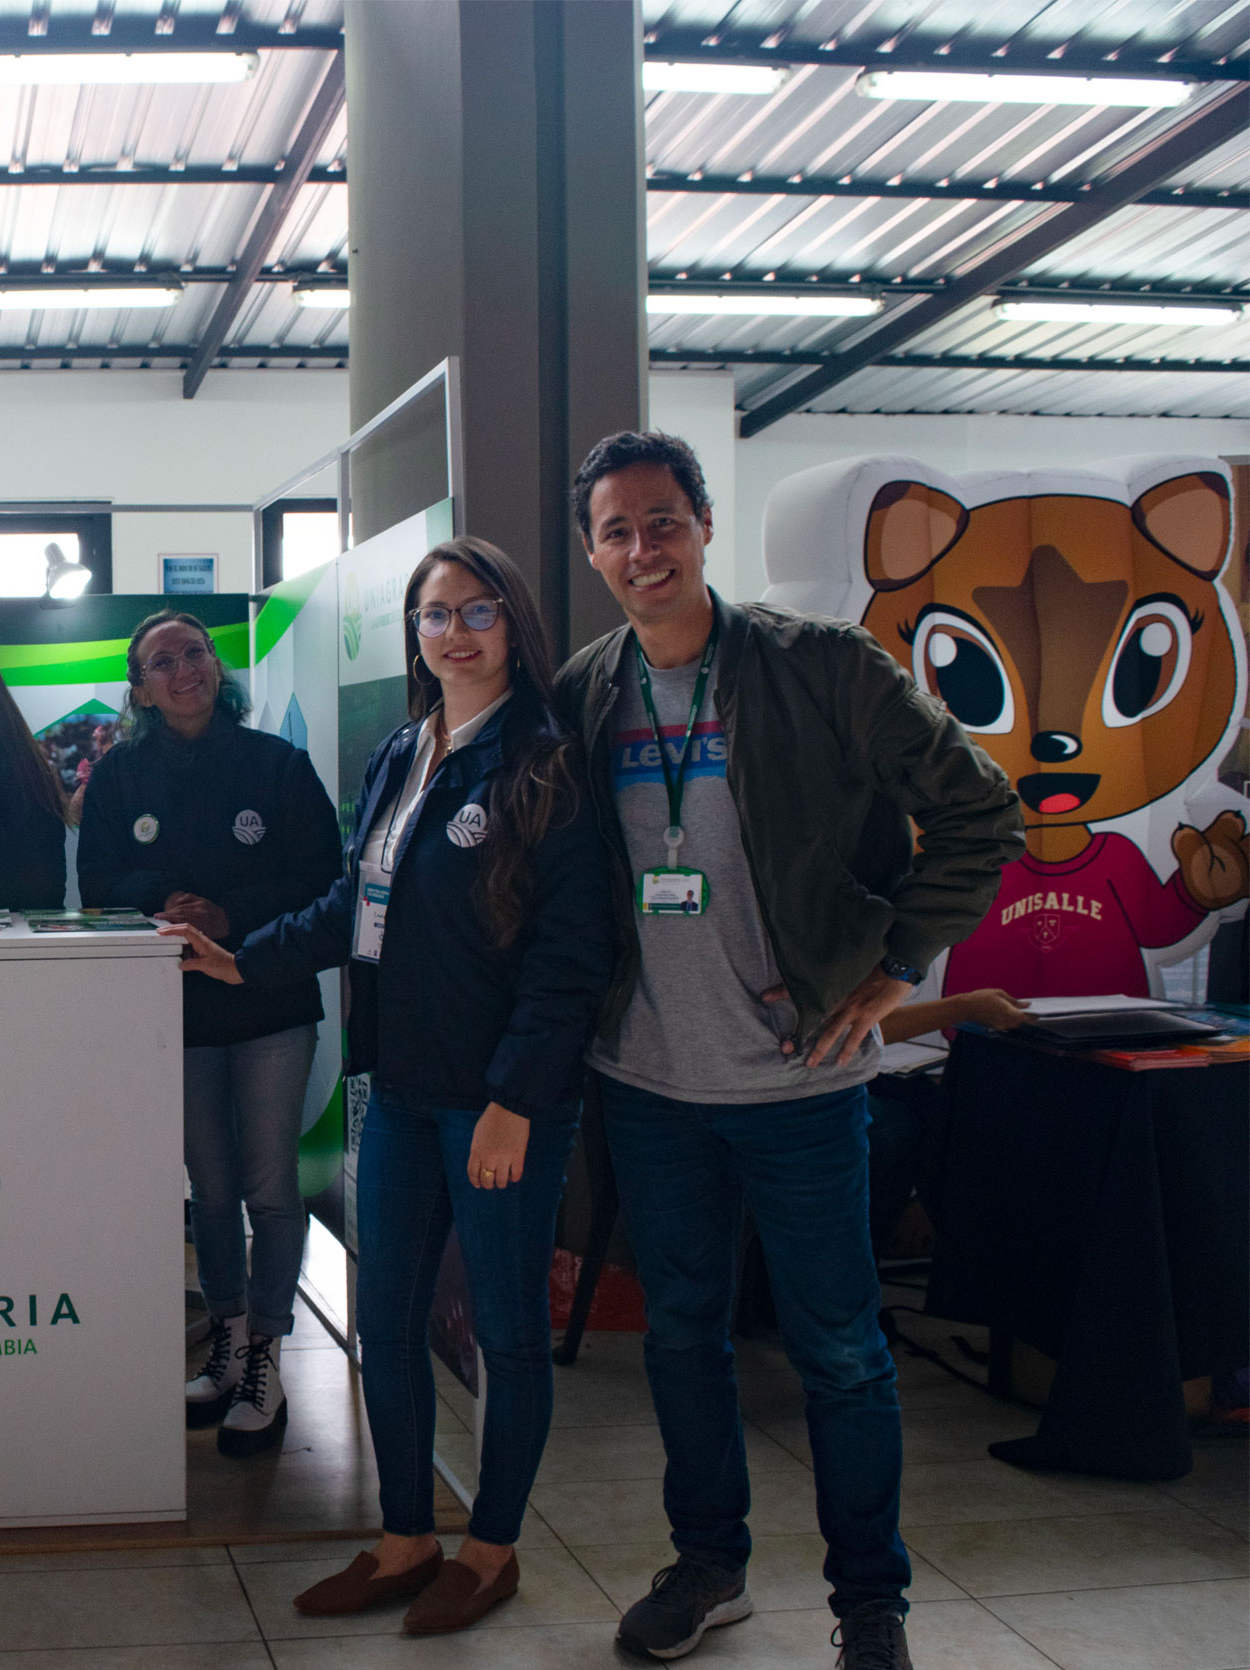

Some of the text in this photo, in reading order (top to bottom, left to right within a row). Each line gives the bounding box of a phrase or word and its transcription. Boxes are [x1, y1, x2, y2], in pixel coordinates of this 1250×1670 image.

[240, 815, 259, 827] UA
[459, 810, 481, 828] UA
[1001, 891, 1102, 926] UNISALLE
